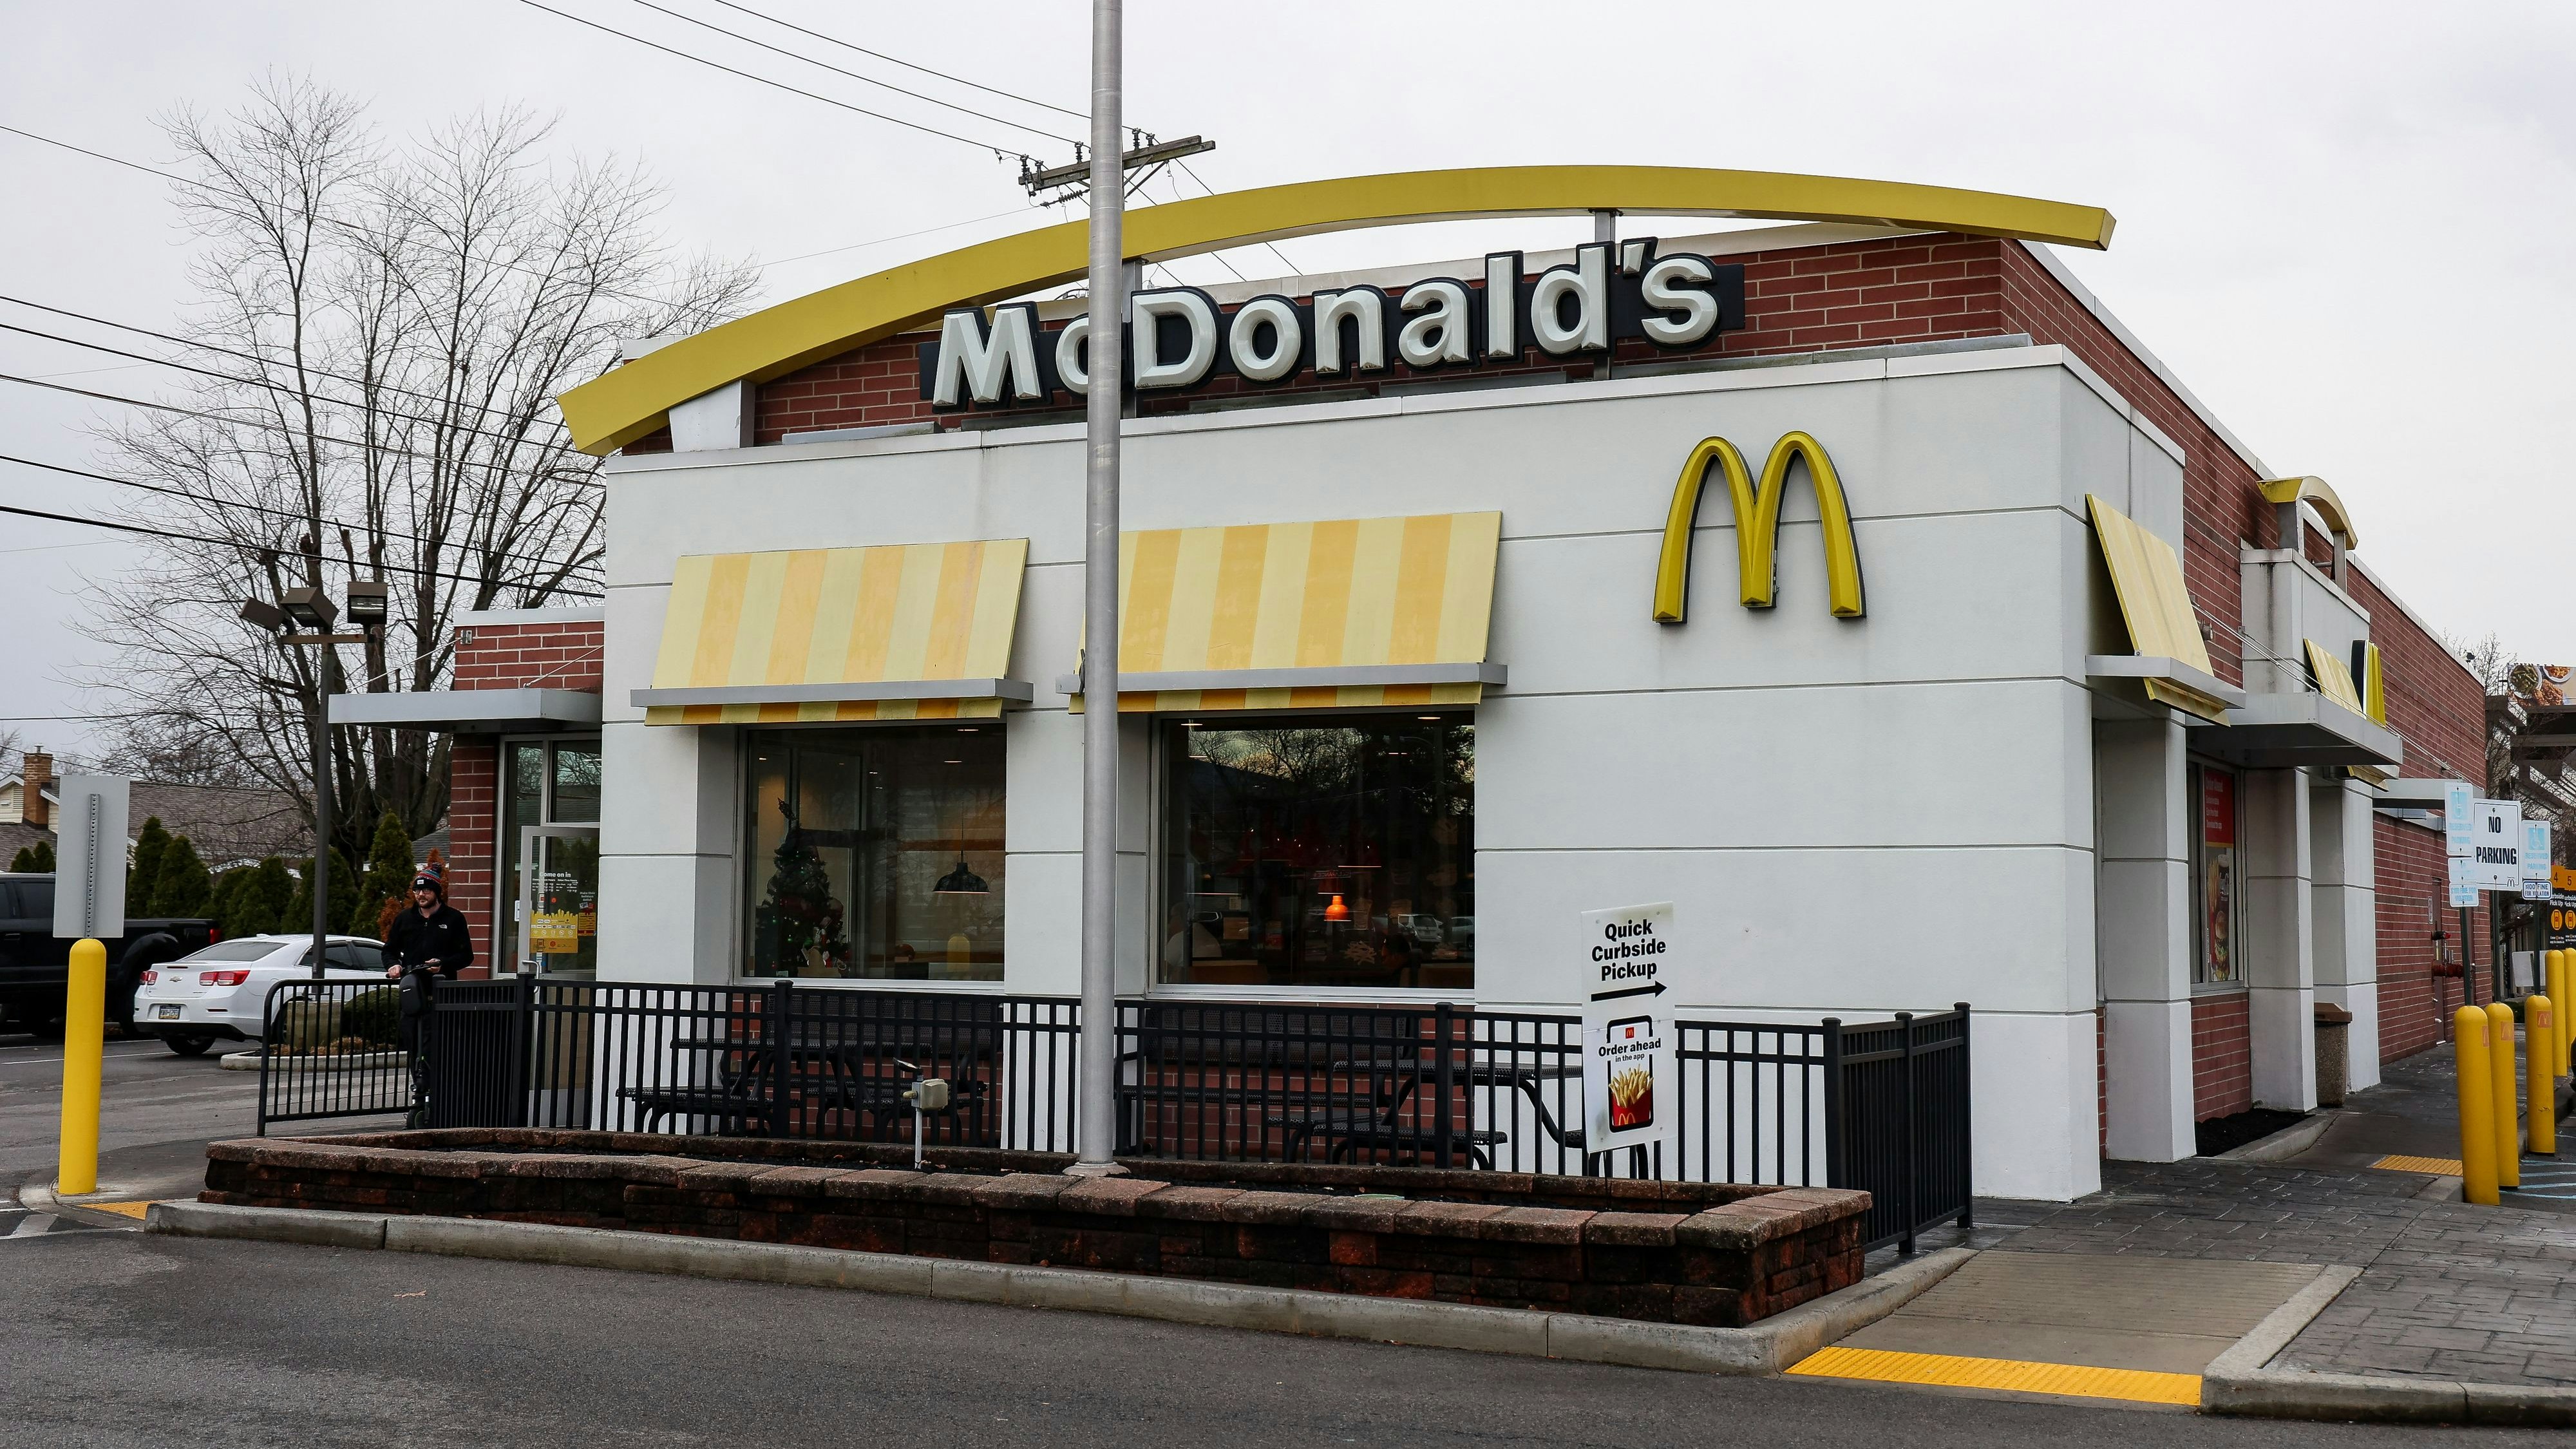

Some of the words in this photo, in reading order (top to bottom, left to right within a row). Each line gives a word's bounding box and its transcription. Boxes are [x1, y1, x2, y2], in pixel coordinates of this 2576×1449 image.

[933, 240, 1718, 406] McDonald's
[2488, 817, 2501, 833] NO
[2476, 846, 2517, 864] PARKING
[2554, 871, 2559, 882] 4
[2568, 876, 2571, 886] 5
[1605, 919, 1653, 942] Quick
[1592, 938, 1666, 961] Curbside
[1602, 962, 1657, 981] Pickup
[1598, 1044, 1628, 1057] Order
[1630, 1037, 1661, 1052] ahead
